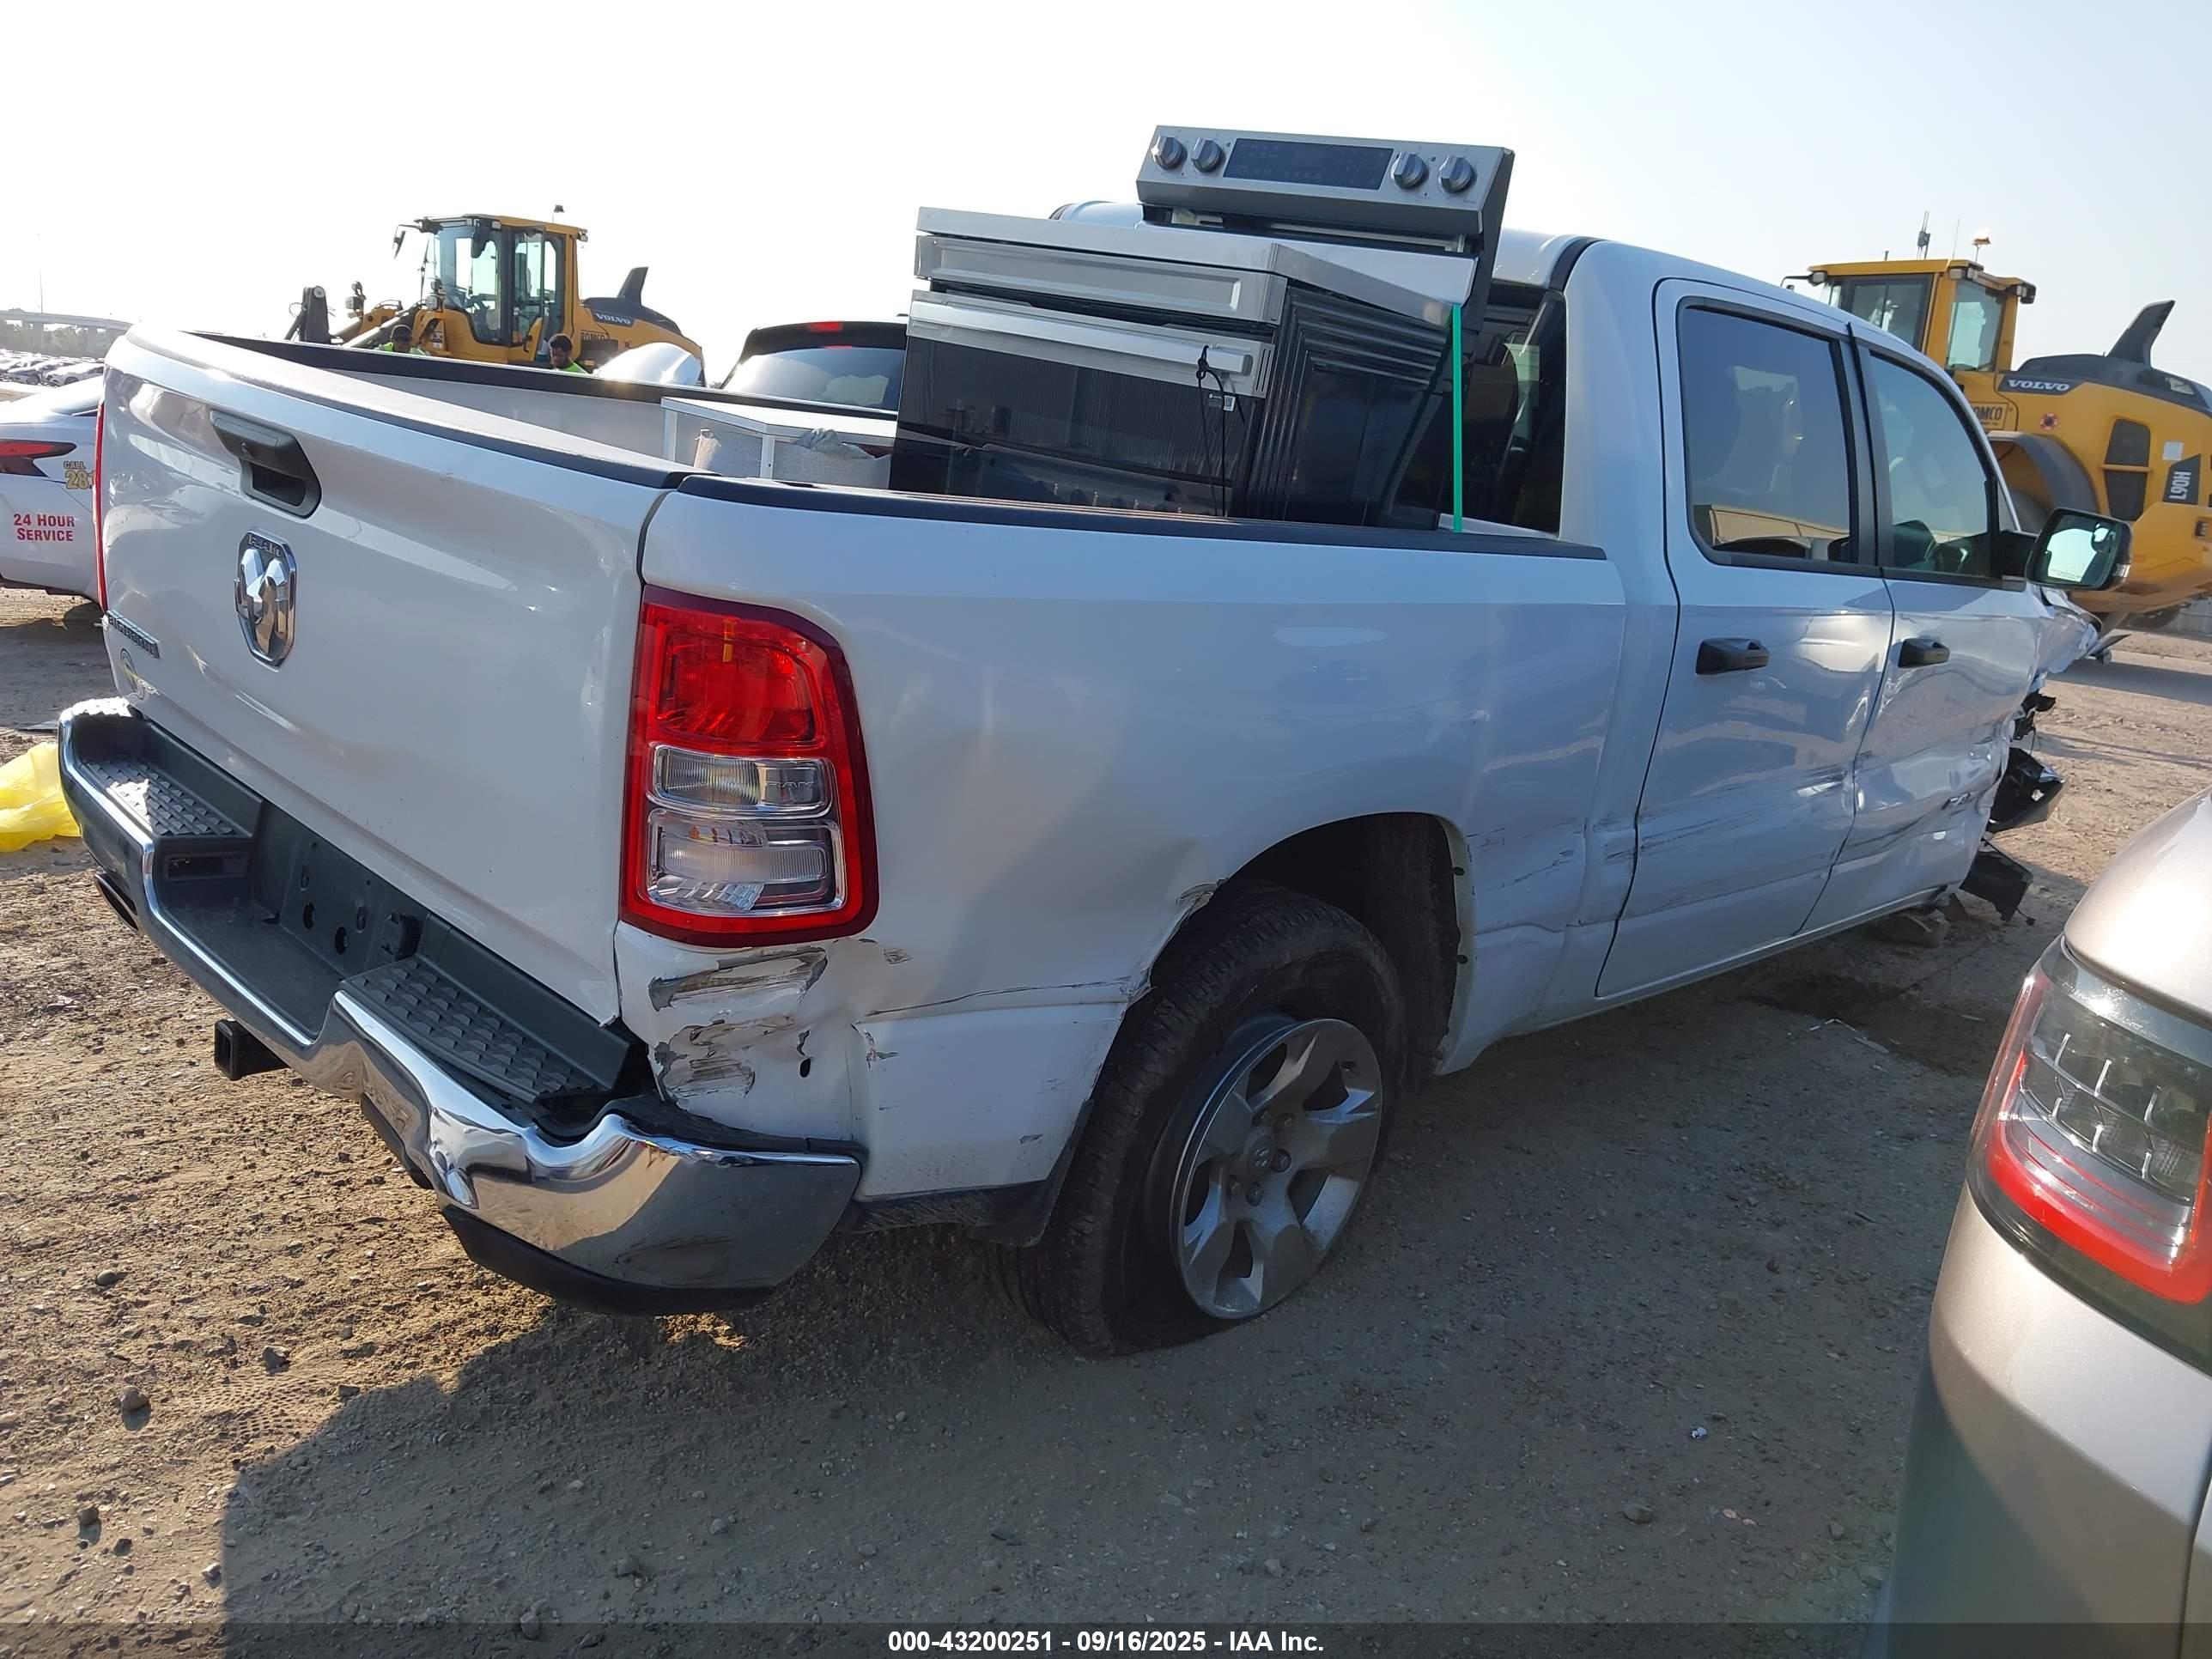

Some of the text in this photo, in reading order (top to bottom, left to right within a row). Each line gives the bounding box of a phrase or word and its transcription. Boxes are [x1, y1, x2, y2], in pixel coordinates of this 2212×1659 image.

[595, 313, 631, 325] VOLVO
[2008, 380, 2069, 392] VOLVO
[2168, 471, 2191, 500] L90H
[14, 514, 75, 527] 24 HOUR
[17, 528, 73, 541] SERVICE
